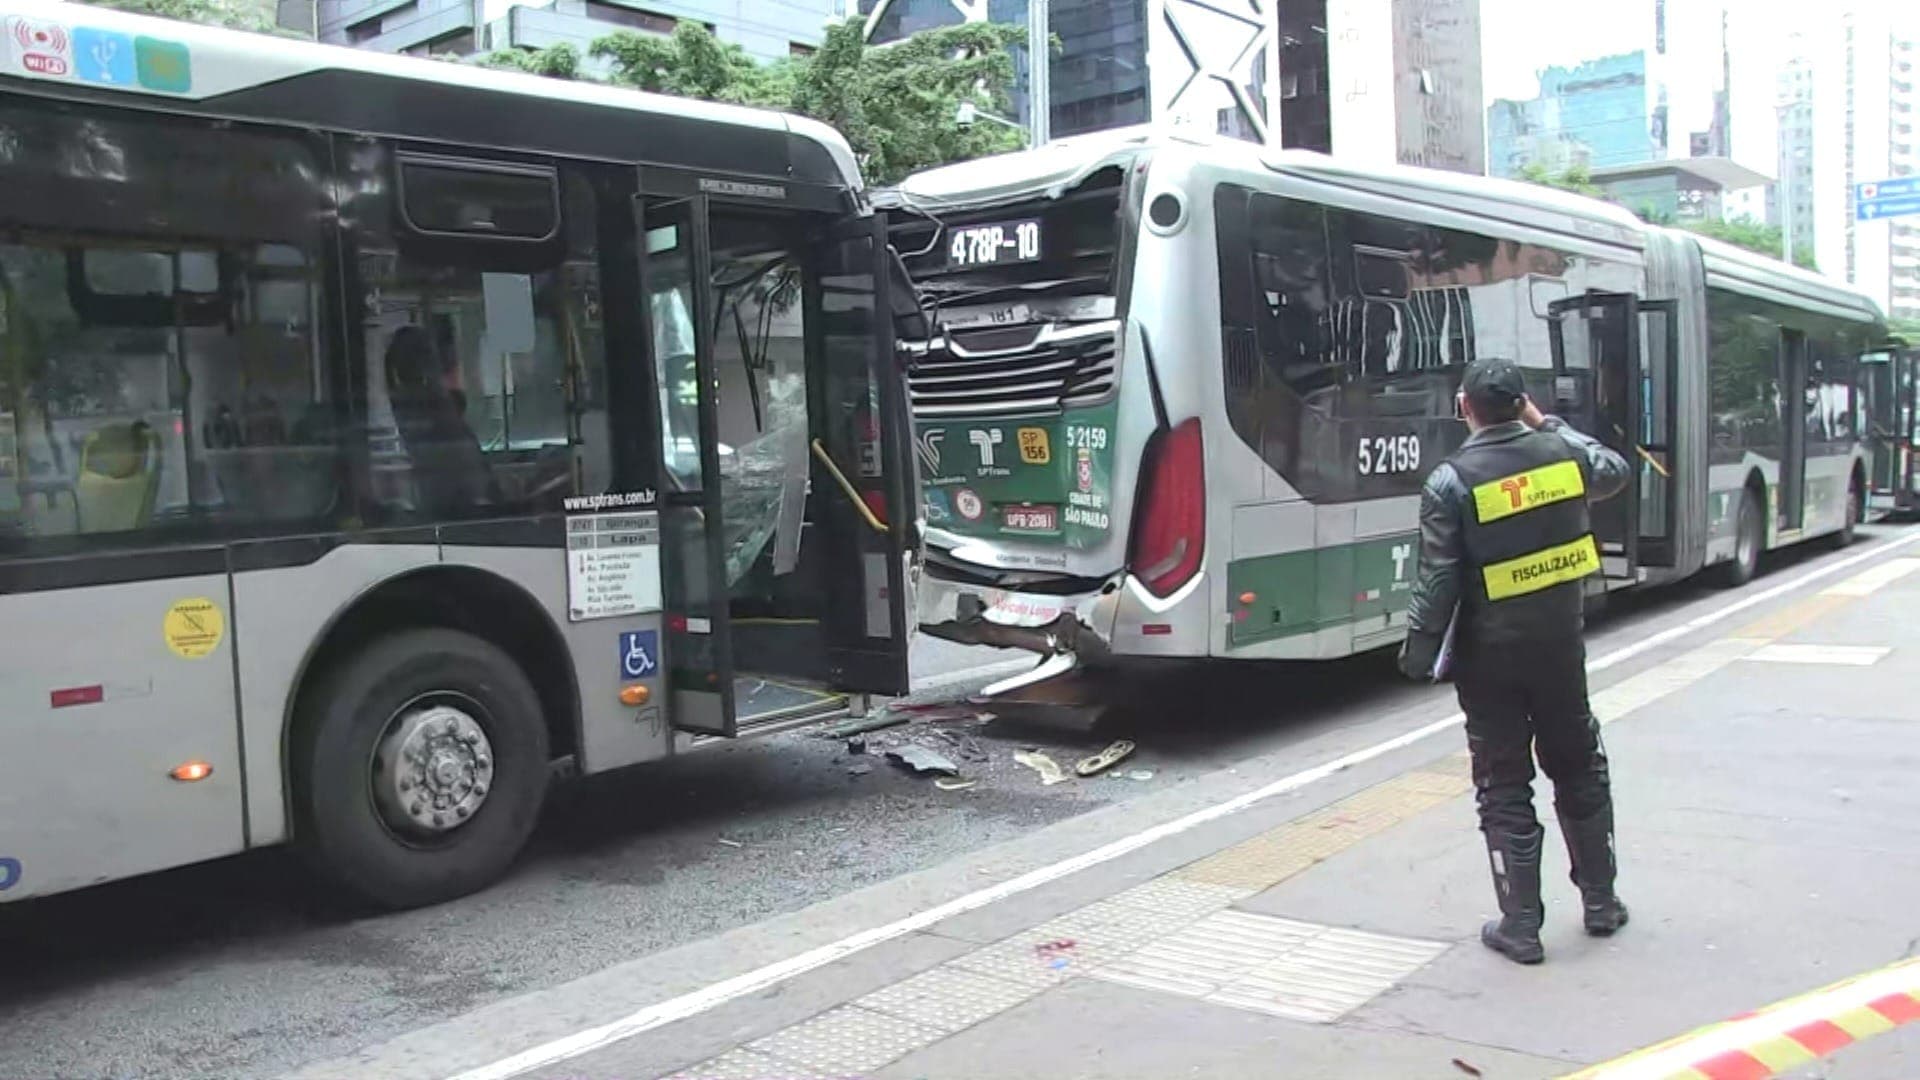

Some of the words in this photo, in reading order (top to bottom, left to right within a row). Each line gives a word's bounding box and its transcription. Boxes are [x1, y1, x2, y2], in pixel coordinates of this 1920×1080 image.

[951, 222, 1039, 265] 478P-10
[1021, 432, 1038, 446] SP
[1024, 446, 1046, 460] 156
[1375, 435, 1420, 473] 2159
[563, 488, 656, 511] www.sptrans.com.br
[1528, 487, 1566, 505] SPTrans
[1081, 510, 1109, 530] PAULO
[611, 534, 646, 545] Lapa
[1512, 549, 1588, 583] FISCALIZAÇÃO
